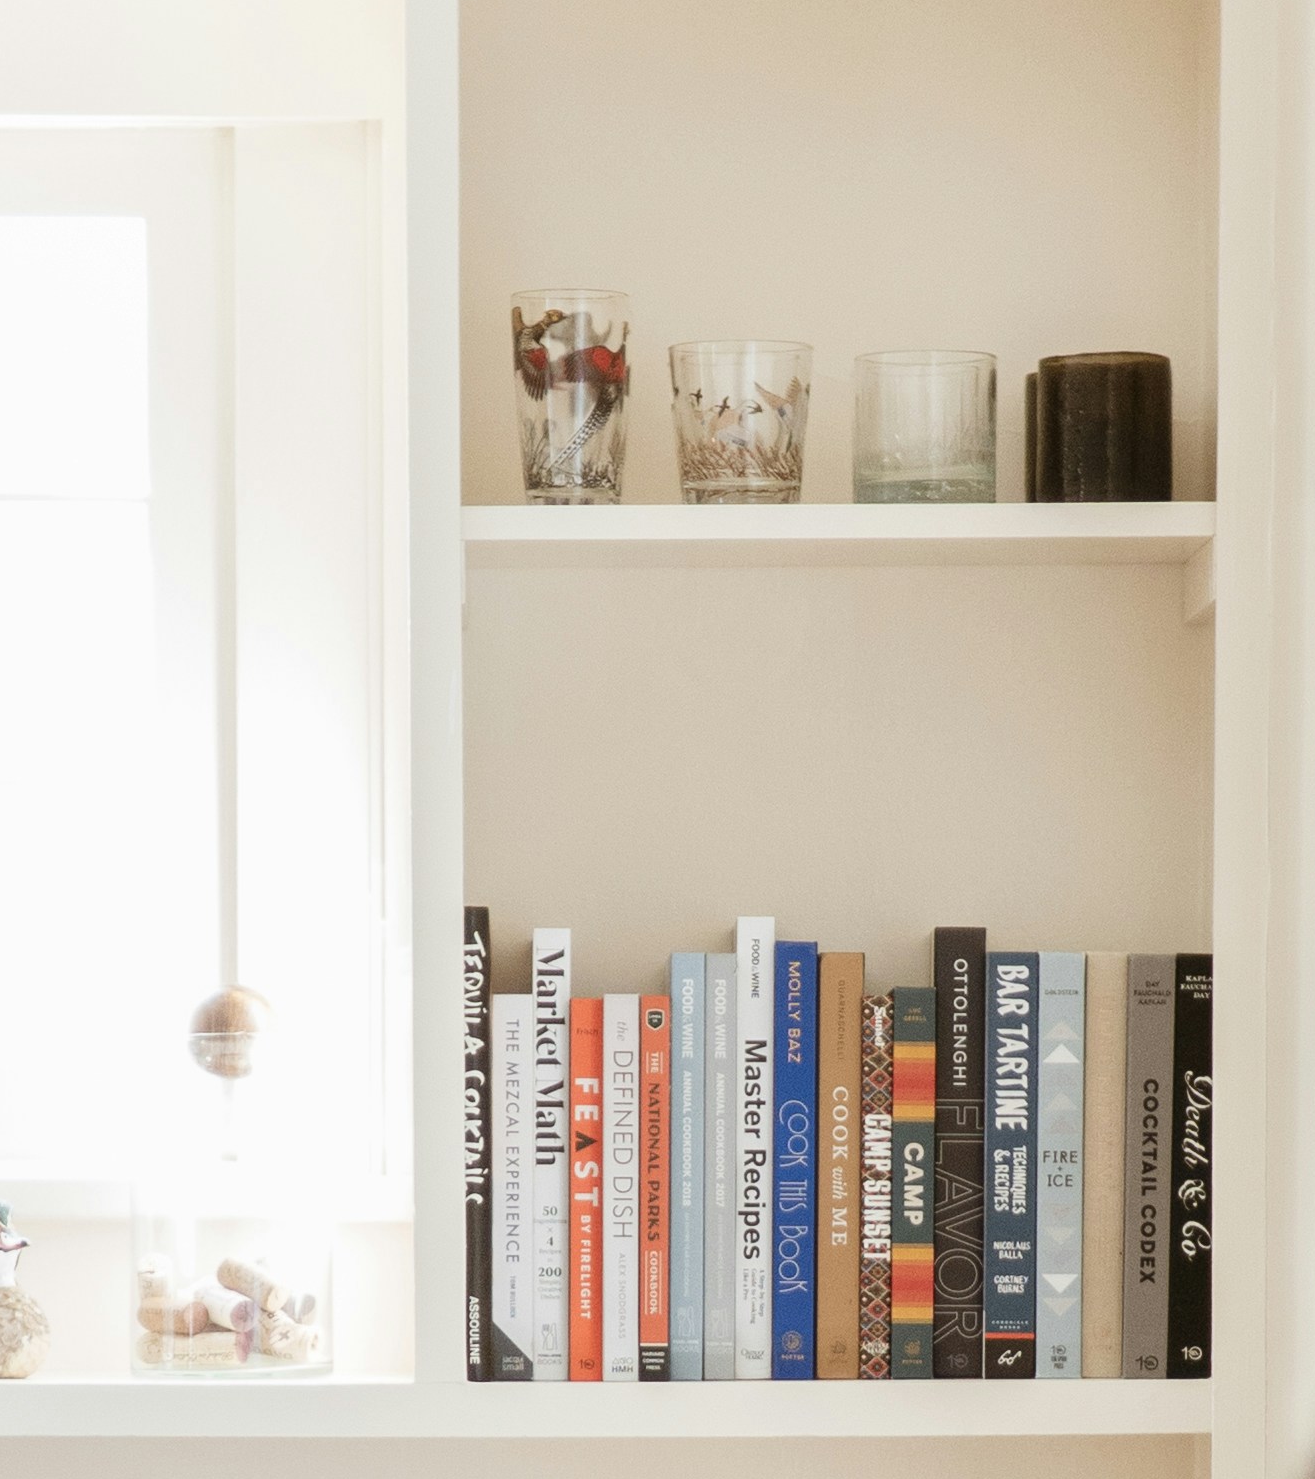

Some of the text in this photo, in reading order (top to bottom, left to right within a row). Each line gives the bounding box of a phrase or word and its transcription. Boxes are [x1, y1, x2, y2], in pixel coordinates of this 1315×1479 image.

[787, 960, 801, 1063] MOLLY BAZ
[953, 957, 969, 1087] OTTOLENGHI
[1193, 991, 1211, 999] DAY
[534, 946, 567, 1167] Market Math
[995, 964, 1030, 1131] BAR TARTINE
[682, 1070, 693, 1114] ANNUAL
[715, 1072, 726, 1116] ANNUAL
[1182, 1070, 1213, 1170] Death
[505, 1018, 520, 1263] THE MEZCAL EXPERIENCE
[612, 1020, 635, 1239] the DEFINED DISH
[682, 1116, 693, 1177] COOKBOOK
[715, 1117, 726, 1179] COOKBOOK
[737, 1039, 769, 1260] Master Recipes
[1043, 1150, 1078, 1164] FIRE
[647, 1051, 661, 1316] THE NATIONAL PARKS COOKBOOK
[682, 1180, 693, 1207] 2018
[715, 1182, 725, 1208] 2017
[831, 1084, 849, 1246] COOK with ME
[862, 1113, 892, 1262] CAMP SUNSET
[903, 1142, 925, 1226] CAMP
[993, 1148, 1011, 1213] & RECIPES
[1011, 1145, 1028, 1215] TECHNIQUES
[1047, 1174, 1074, 1187] ICE
[1138, 1077, 1161, 1284] COCKTAIL CODEX
[1178, 1179, 1208, 1211] &
[542, 1206, 558, 1217] 50
[579, 1214, 592, 1233] BY
[934, 1099, 984, 1345] FLAVOR
[538, 1267, 562, 1278] 200
[579, 1239, 592, 1320] FIRELIGHT
[618, 1252, 627, 1276] ALEX
[998, 1250, 1024, 1260] BALLA
[469, 1295, 481, 1365] ASSOULINE
